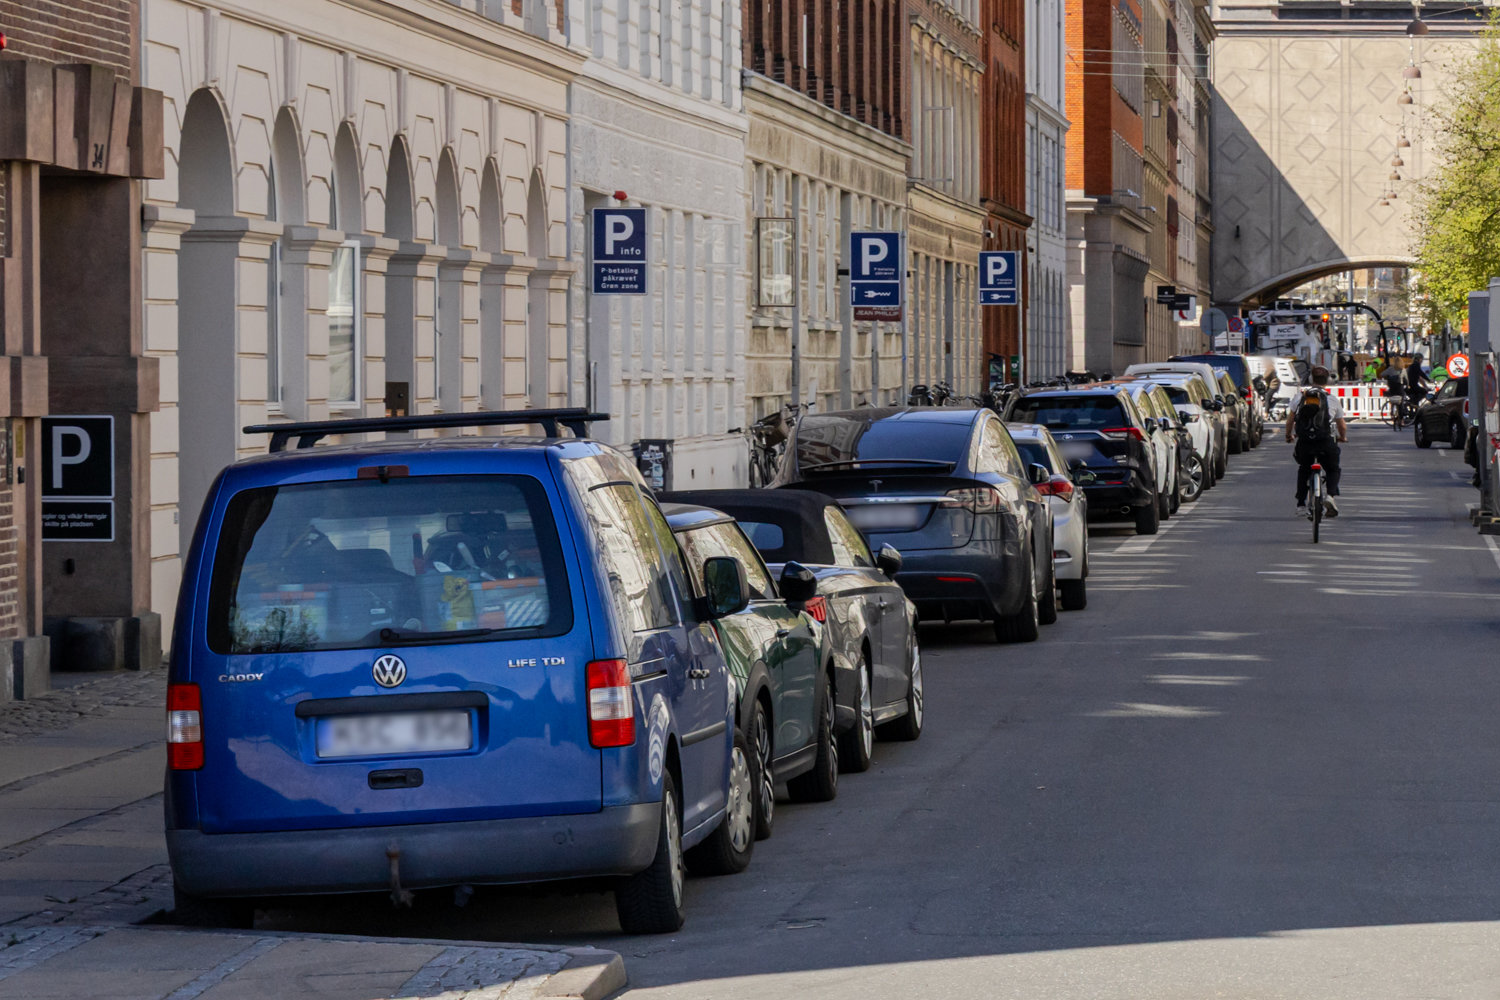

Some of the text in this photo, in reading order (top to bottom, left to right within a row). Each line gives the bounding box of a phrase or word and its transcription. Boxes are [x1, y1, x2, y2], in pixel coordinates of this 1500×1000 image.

[93, 143, 104, 168] 34
[605, 215, 634, 255] P
[620, 247, 641, 255] info
[861, 238, 888, 275] P
[601, 267, 638, 275] P-betaling
[987, 256, 1007, 284] P
[52, 426, 91, 489] P
[508, 657, 566, 668] LIFE TDI
[218, 673, 264, 683] CADDY
